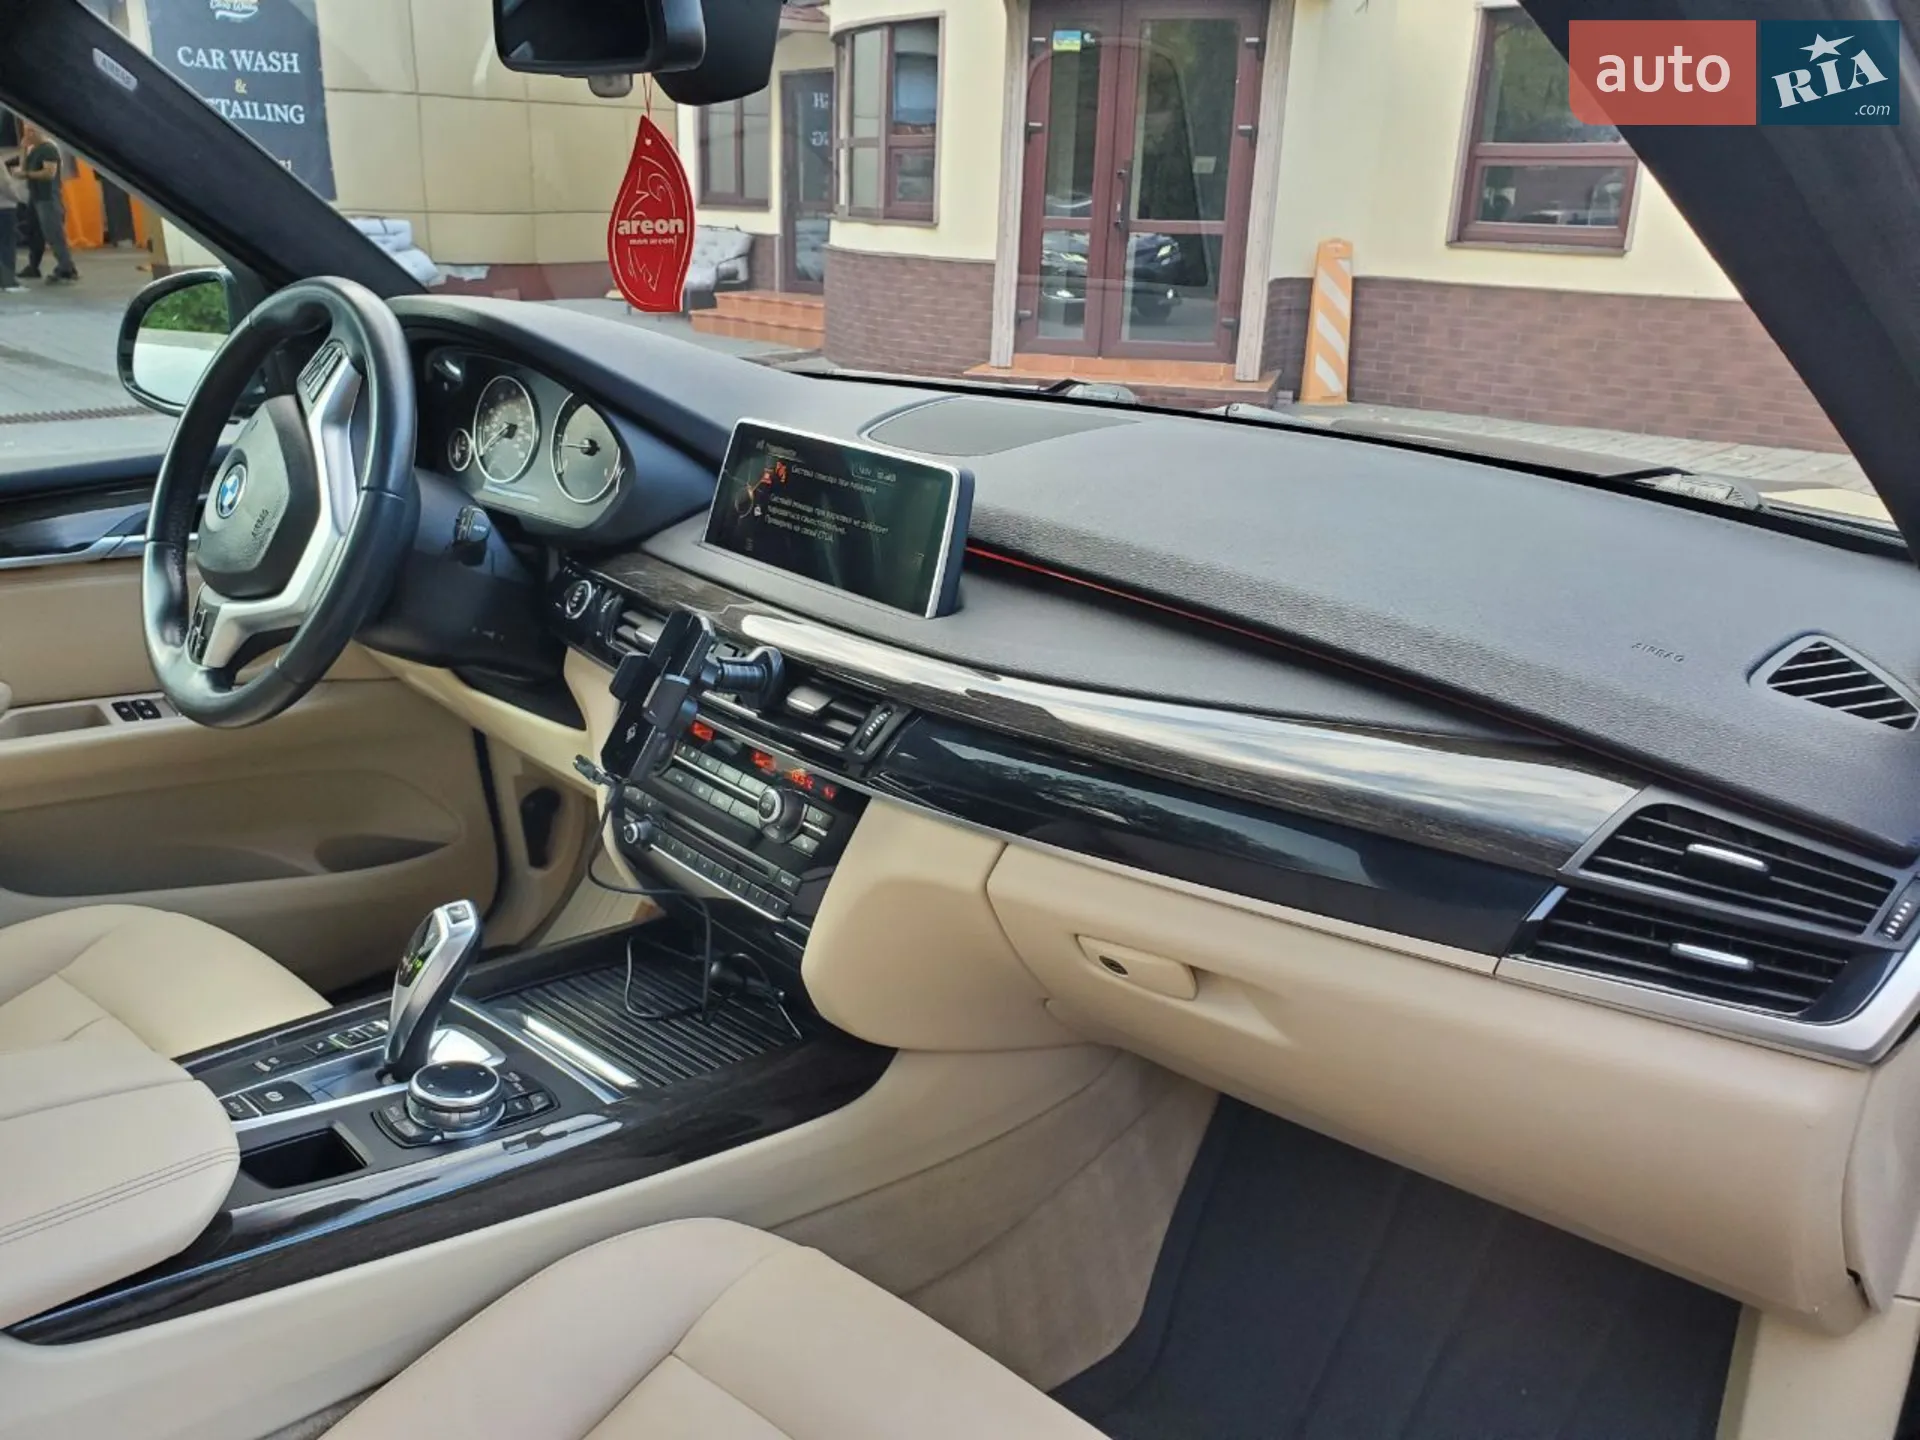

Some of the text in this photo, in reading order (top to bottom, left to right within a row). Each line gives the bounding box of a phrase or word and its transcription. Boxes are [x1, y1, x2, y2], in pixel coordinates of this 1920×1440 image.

[176, 46, 301, 73] CAR WASH
[234, 78, 247, 94] &
[205, 98, 305, 125] TAILING
[617, 218, 685, 235] areon
